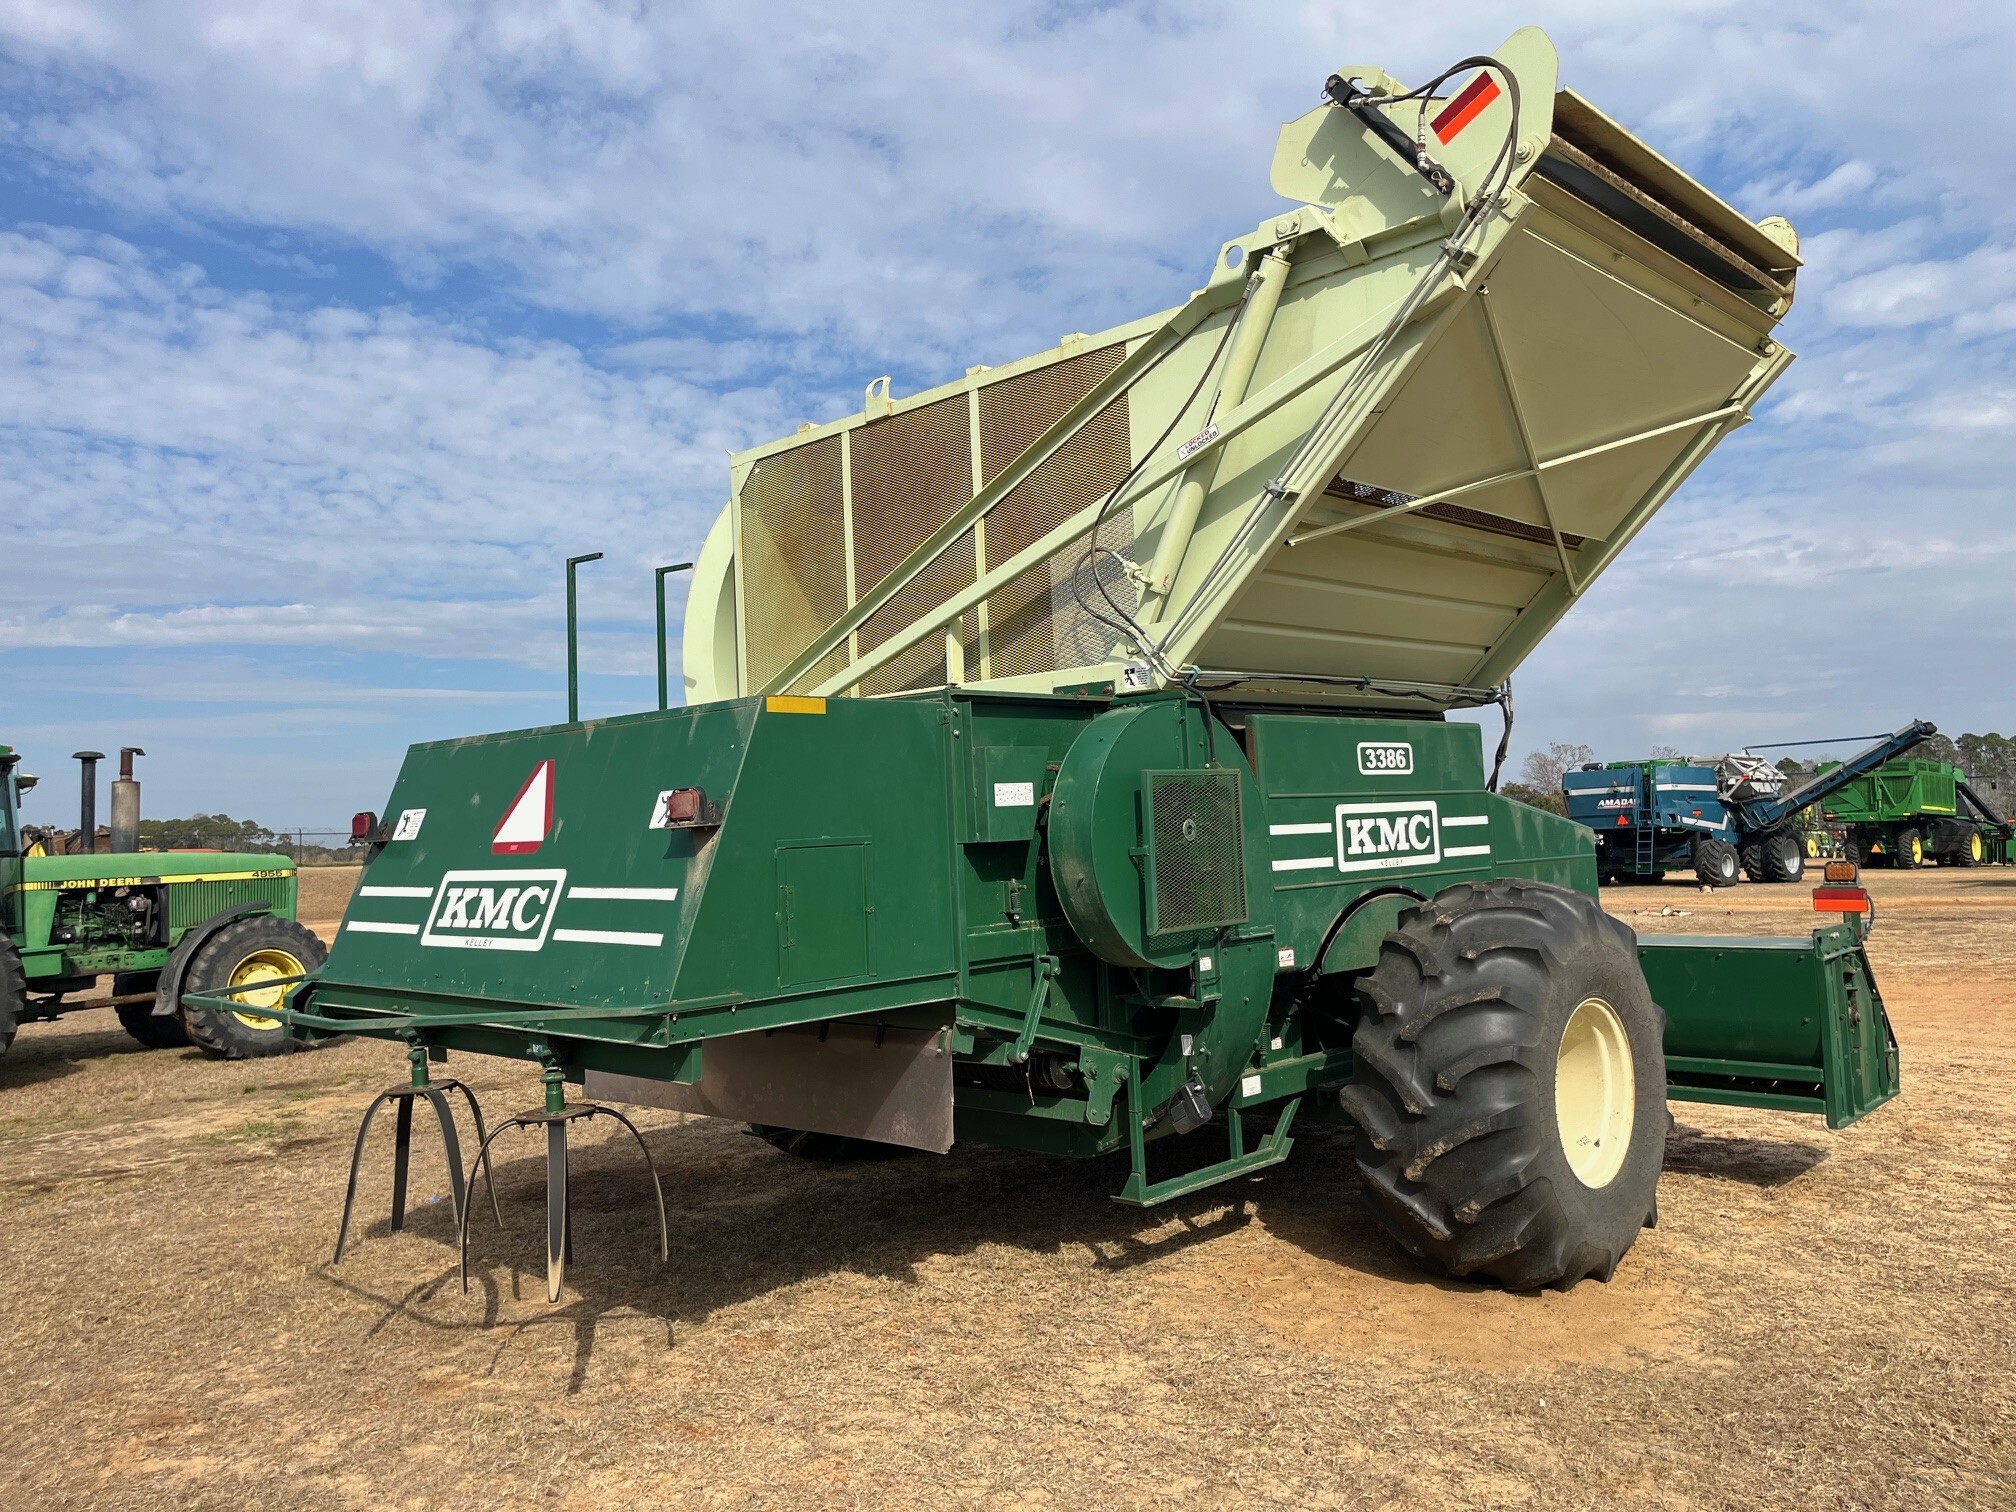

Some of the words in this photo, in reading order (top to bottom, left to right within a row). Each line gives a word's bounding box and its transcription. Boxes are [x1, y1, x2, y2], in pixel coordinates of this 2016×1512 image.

[1184, 429, 1210, 449] LOCKED
[1186, 431, 1217, 454] UNLOCKED
[1365, 748, 1407, 769] 3386
[1346, 814, 1431, 855] KMC
[1380, 858, 1404, 867] KELLEY
[60, 879, 95, 889] JOHN
[99, 877, 142, 887] DEERE
[436, 885, 550, 931] KMC
[464, 938, 494, 947] KELLEY
